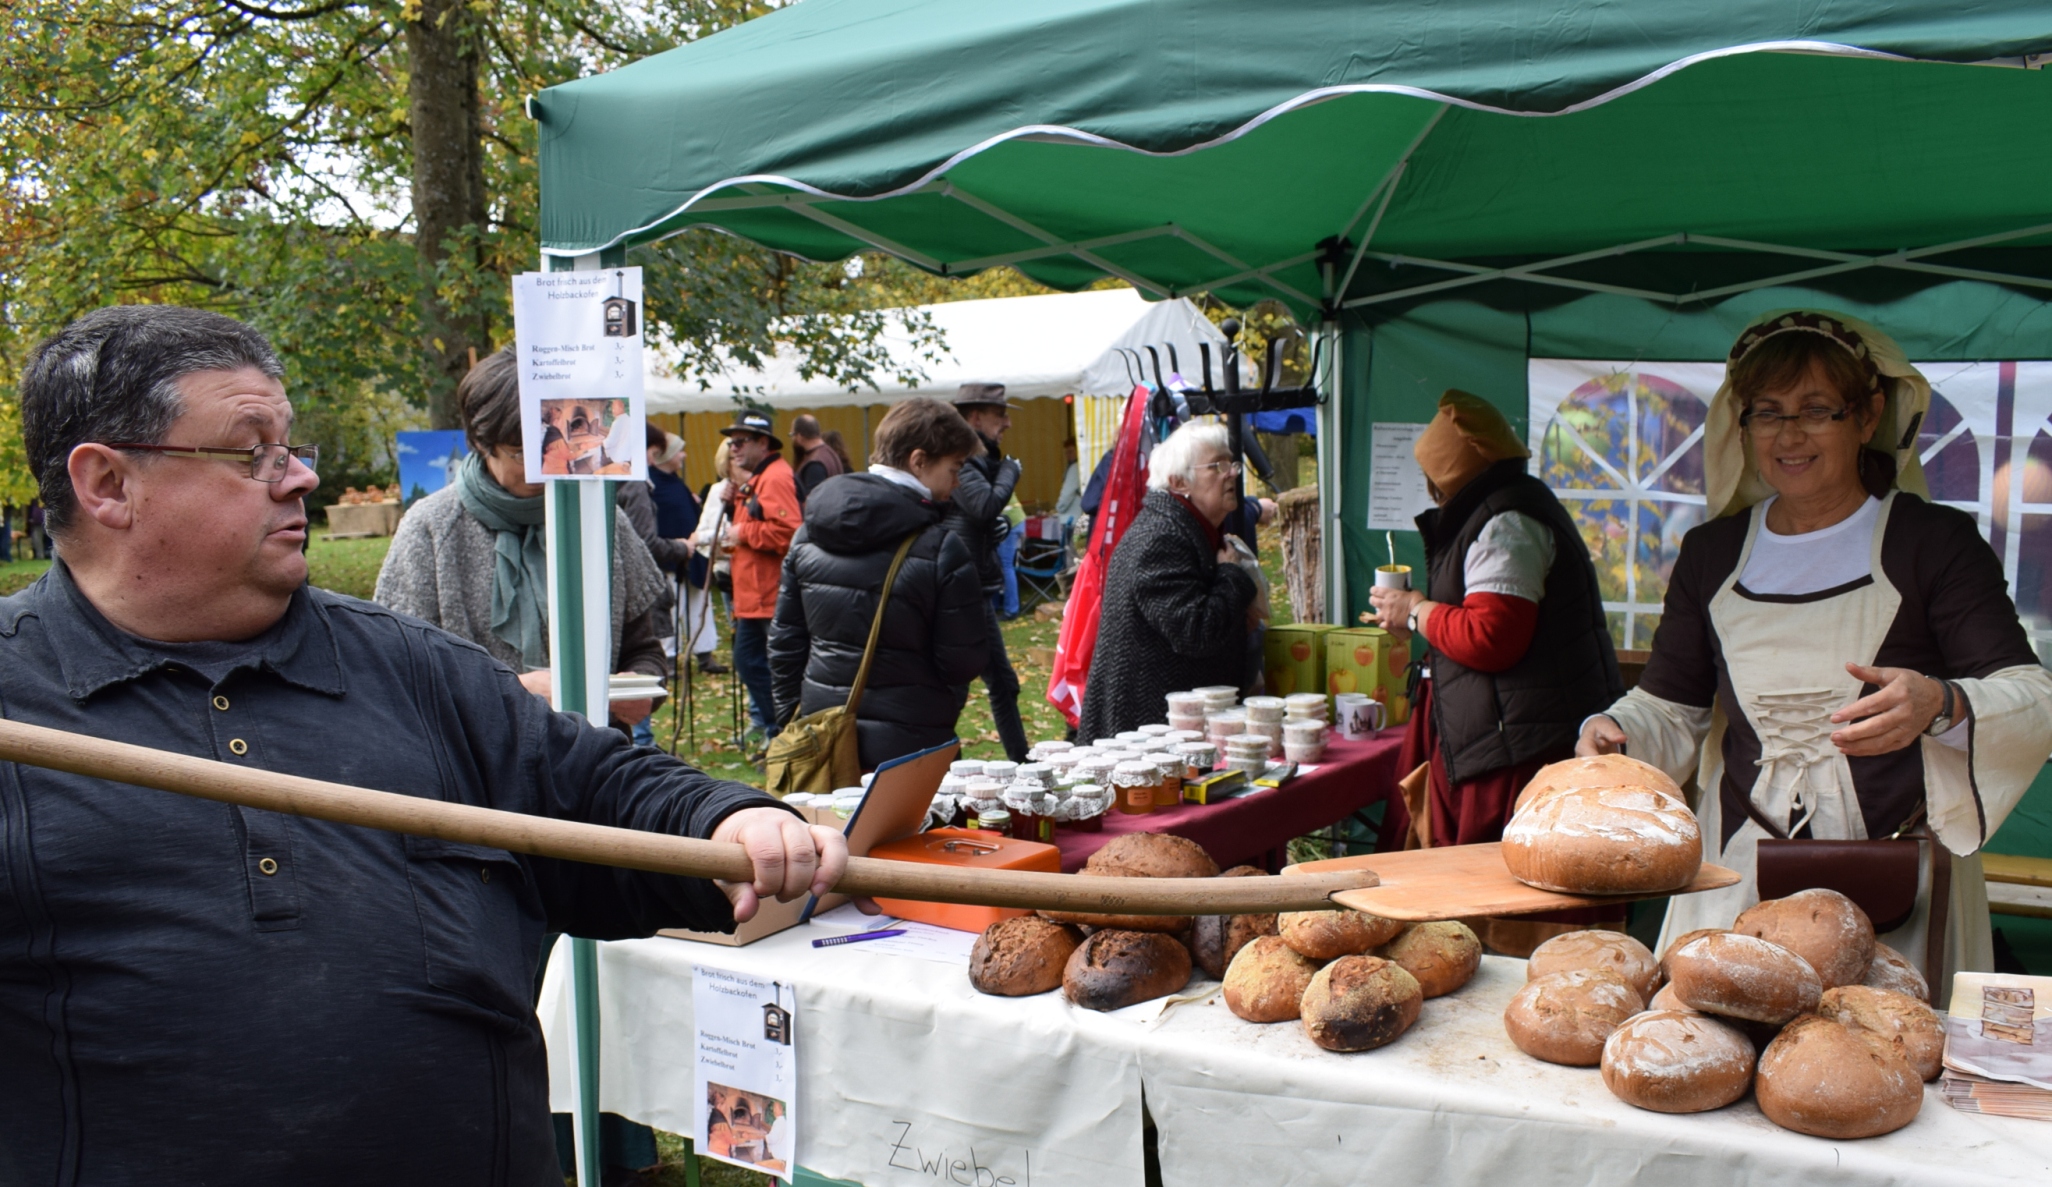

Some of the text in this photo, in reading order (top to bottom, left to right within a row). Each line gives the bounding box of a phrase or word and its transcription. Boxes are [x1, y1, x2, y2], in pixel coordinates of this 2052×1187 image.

[536, 278, 556, 287] Brot
[557, 277, 577, 286] frisch
[547, 289, 599, 300] Holzbackofen
[532, 344, 580, 354] Roggen-Misch
[581, 343, 596, 352] Brot
[532, 359, 576, 367] Kartoffelbrot
[701, 968, 766, 989] Brot frisch aus dem
[710, 983, 758, 999] Holzbackofen
[742, 1039, 756, 1050] Brot
[700, 1043, 738, 1059] Kartoffelbrot
